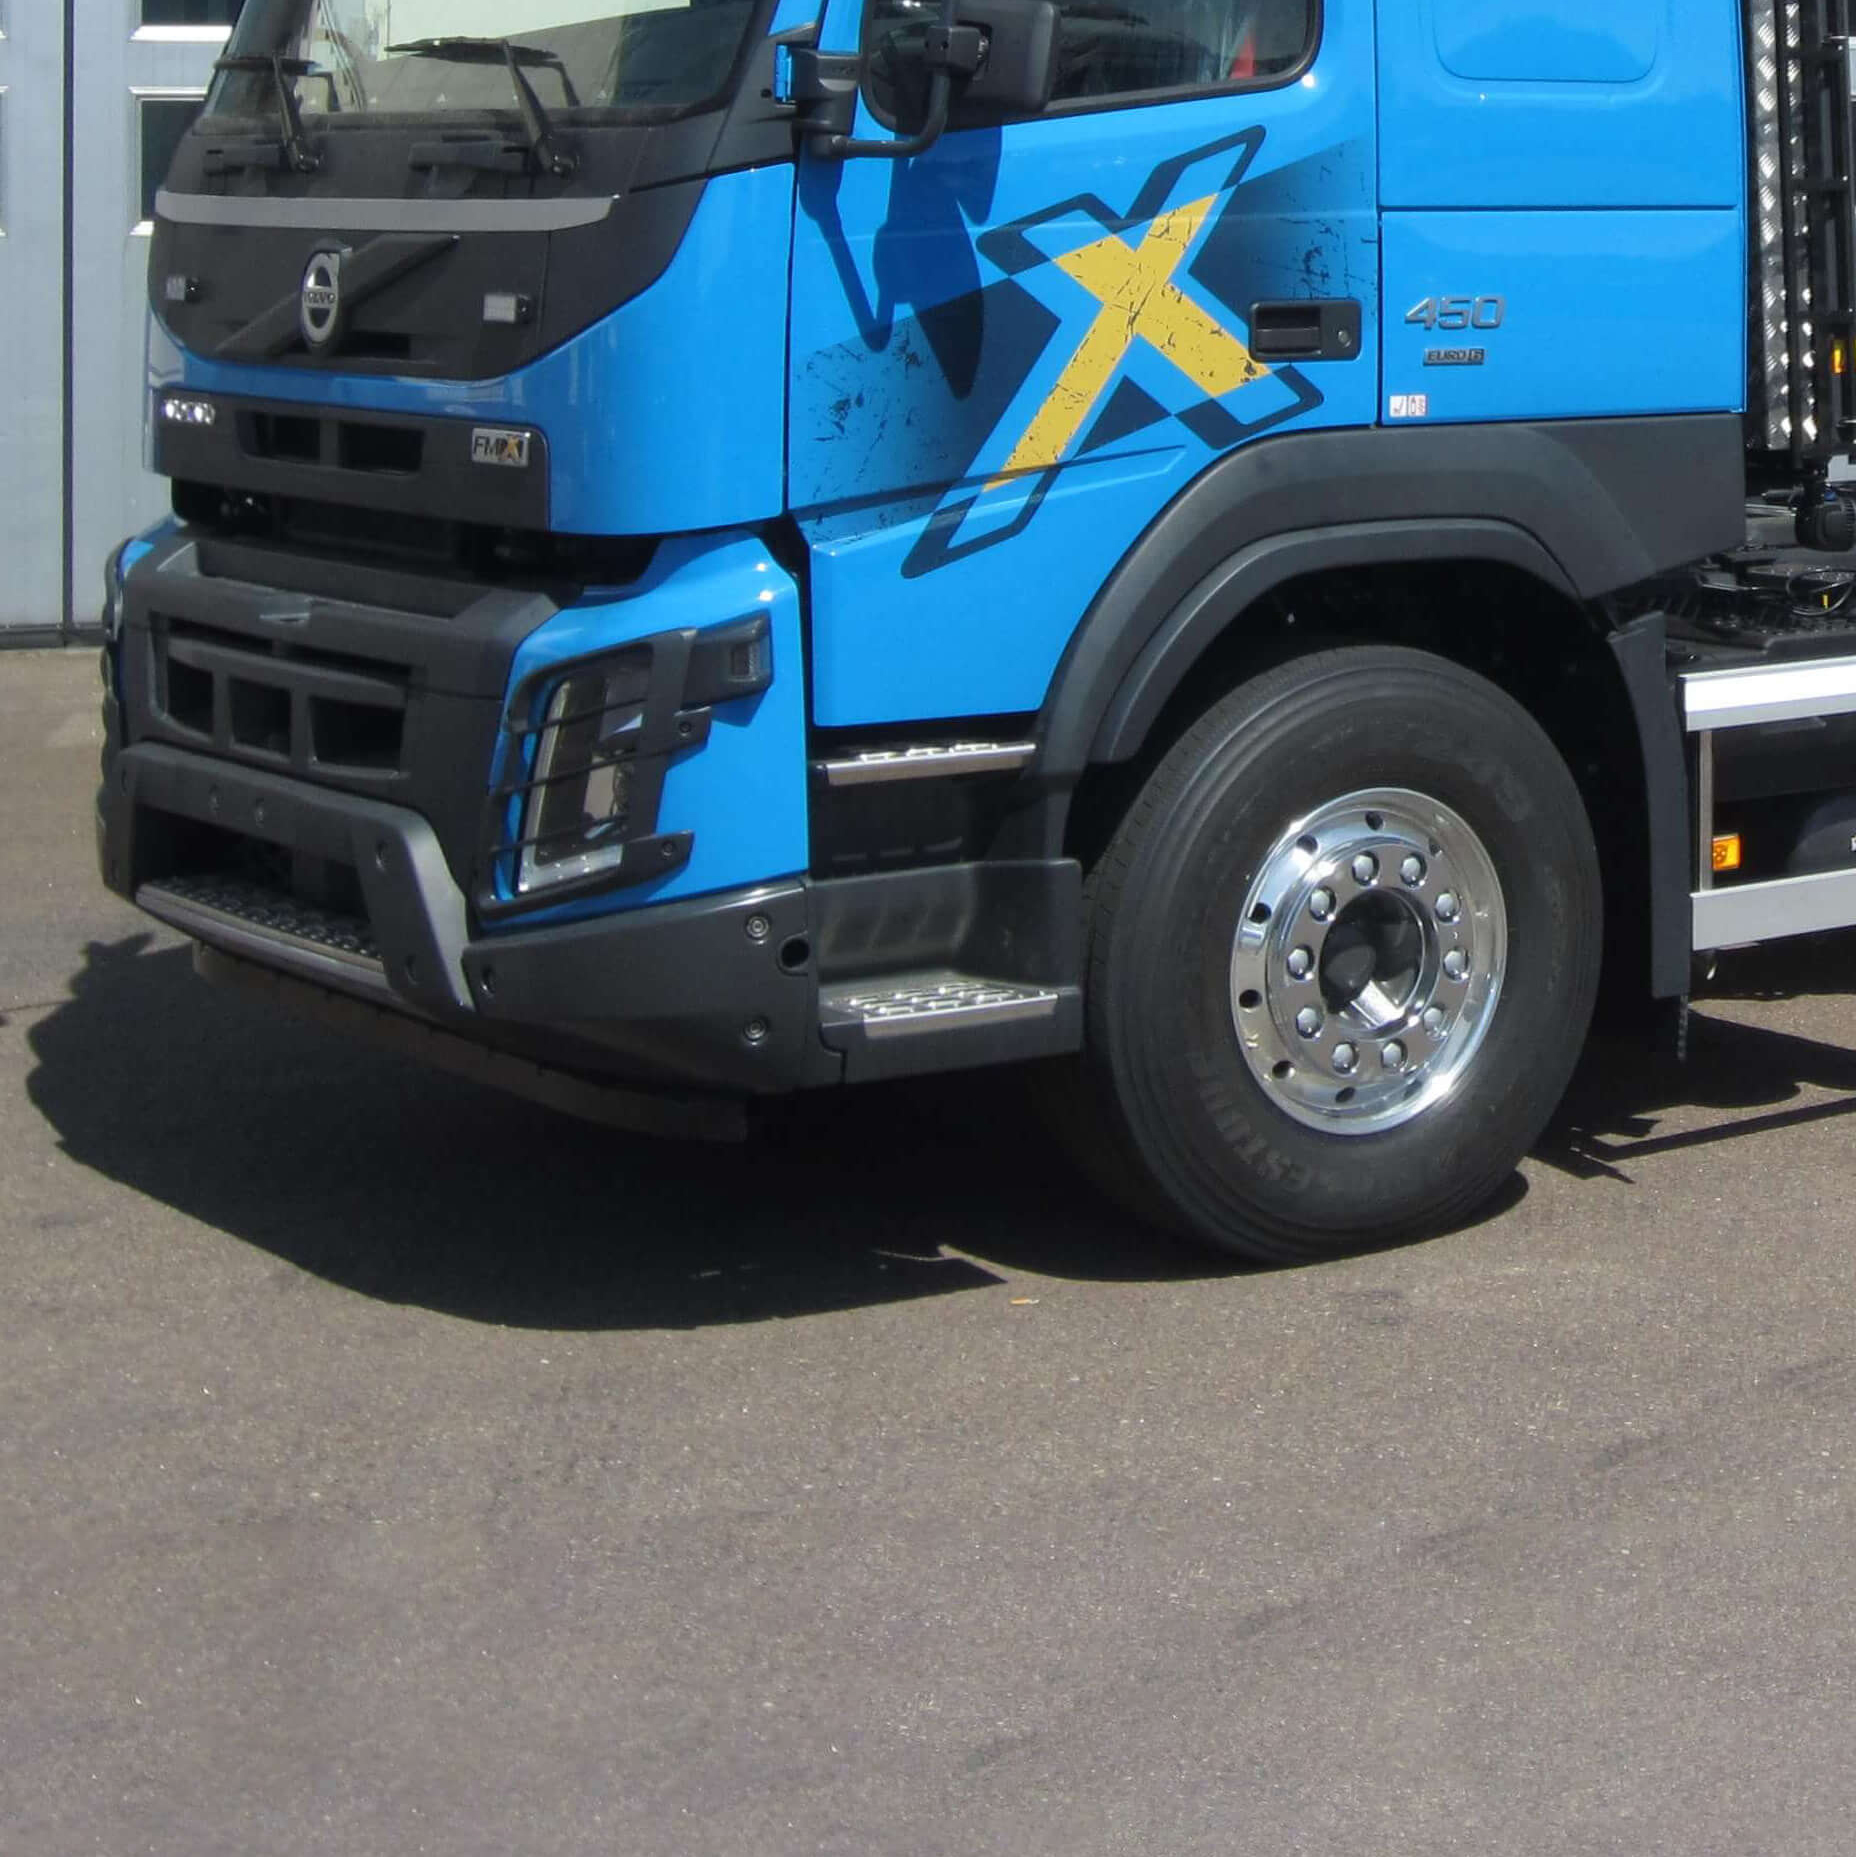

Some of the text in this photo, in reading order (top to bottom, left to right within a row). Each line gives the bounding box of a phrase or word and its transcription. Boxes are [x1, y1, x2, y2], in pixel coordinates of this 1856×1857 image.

[1404, 295, 1505, 331] 450
[1427, 349, 1467, 362] EURO
[473, 434, 523, 463] FMX
